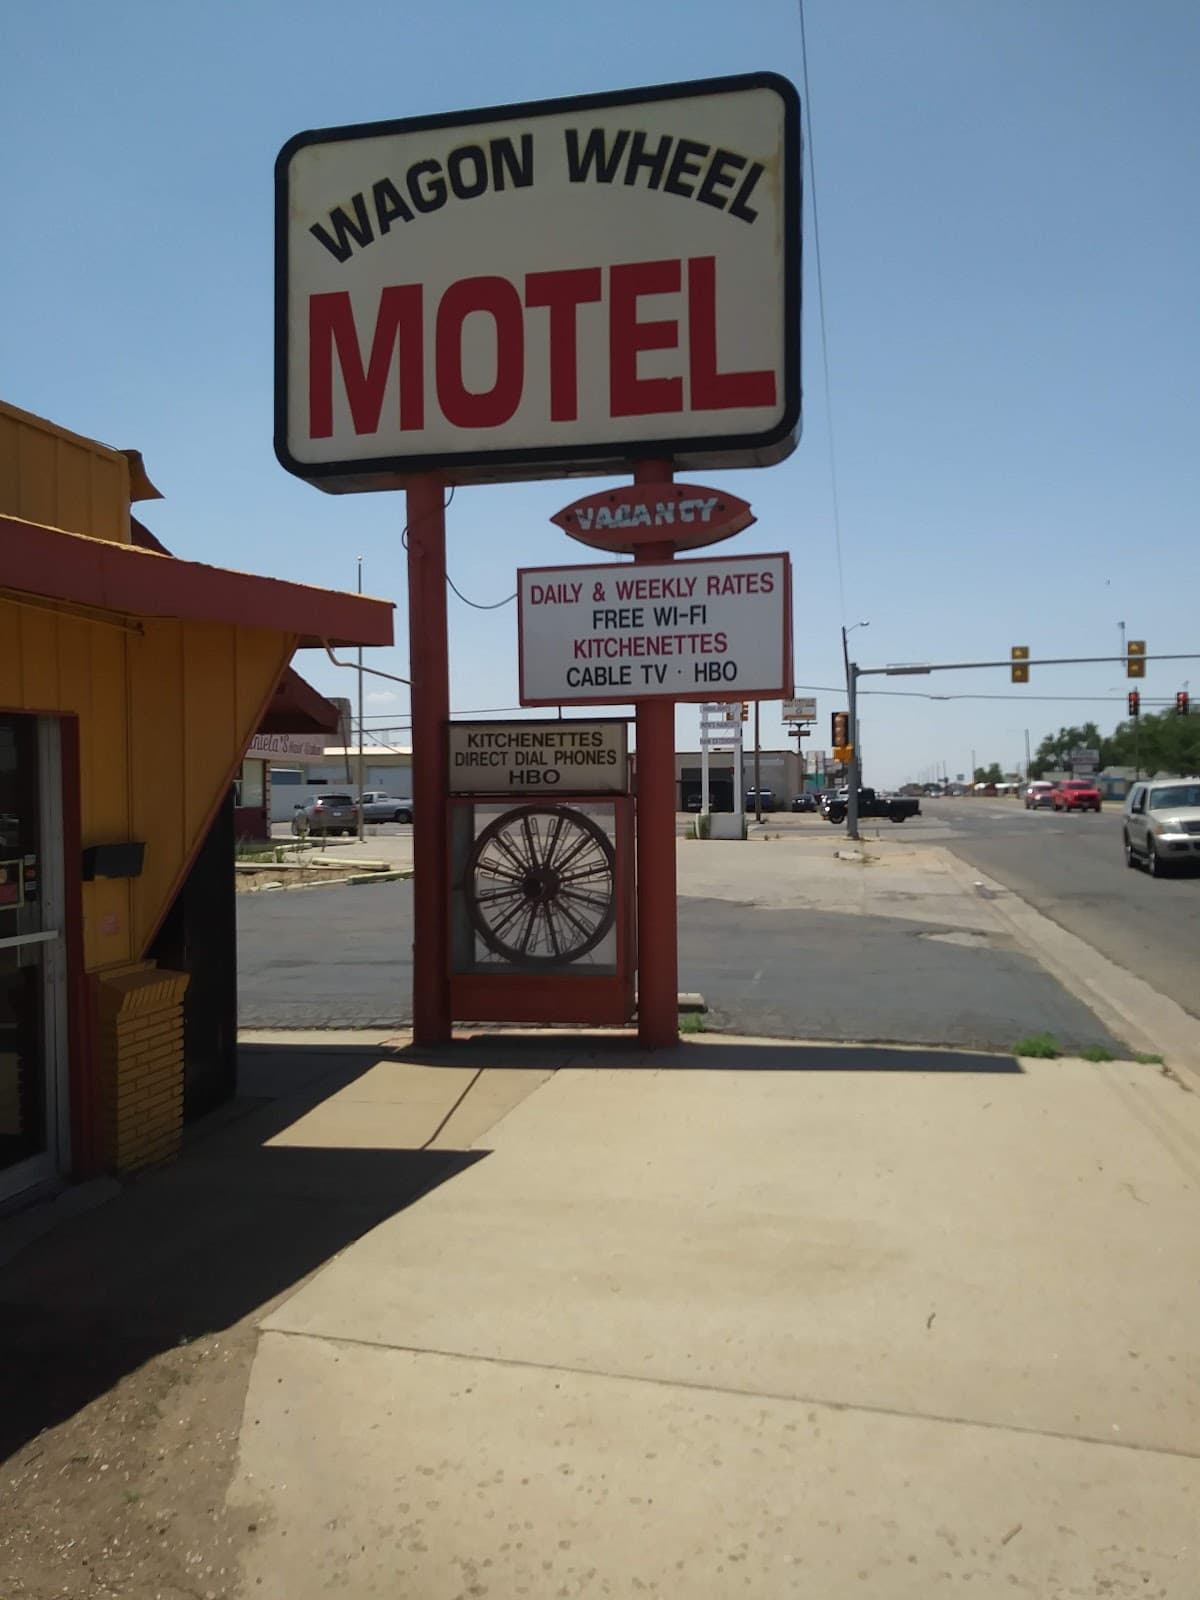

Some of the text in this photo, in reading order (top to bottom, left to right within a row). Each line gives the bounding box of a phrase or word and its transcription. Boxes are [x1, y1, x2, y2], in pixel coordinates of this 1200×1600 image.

[309, 128, 765, 263] WAGON WHEEL
[309, 256, 777, 439] MOTEL
[575, 498, 718, 530] VACANCY
[531, 572, 773, 604] DAILY & WEEKLY RATES
[593, 605, 706, 629] FREE WI-FI
[574, 633, 727, 659] KITCHENETTES
[567, 661, 737, 687] CABLE TV HBO
[468, 732, 602, 747] KITCHENETTES
[456, 750, 616, 766] DIRECT DIAL PHONES
[509, 769, 560, 784] HBO
